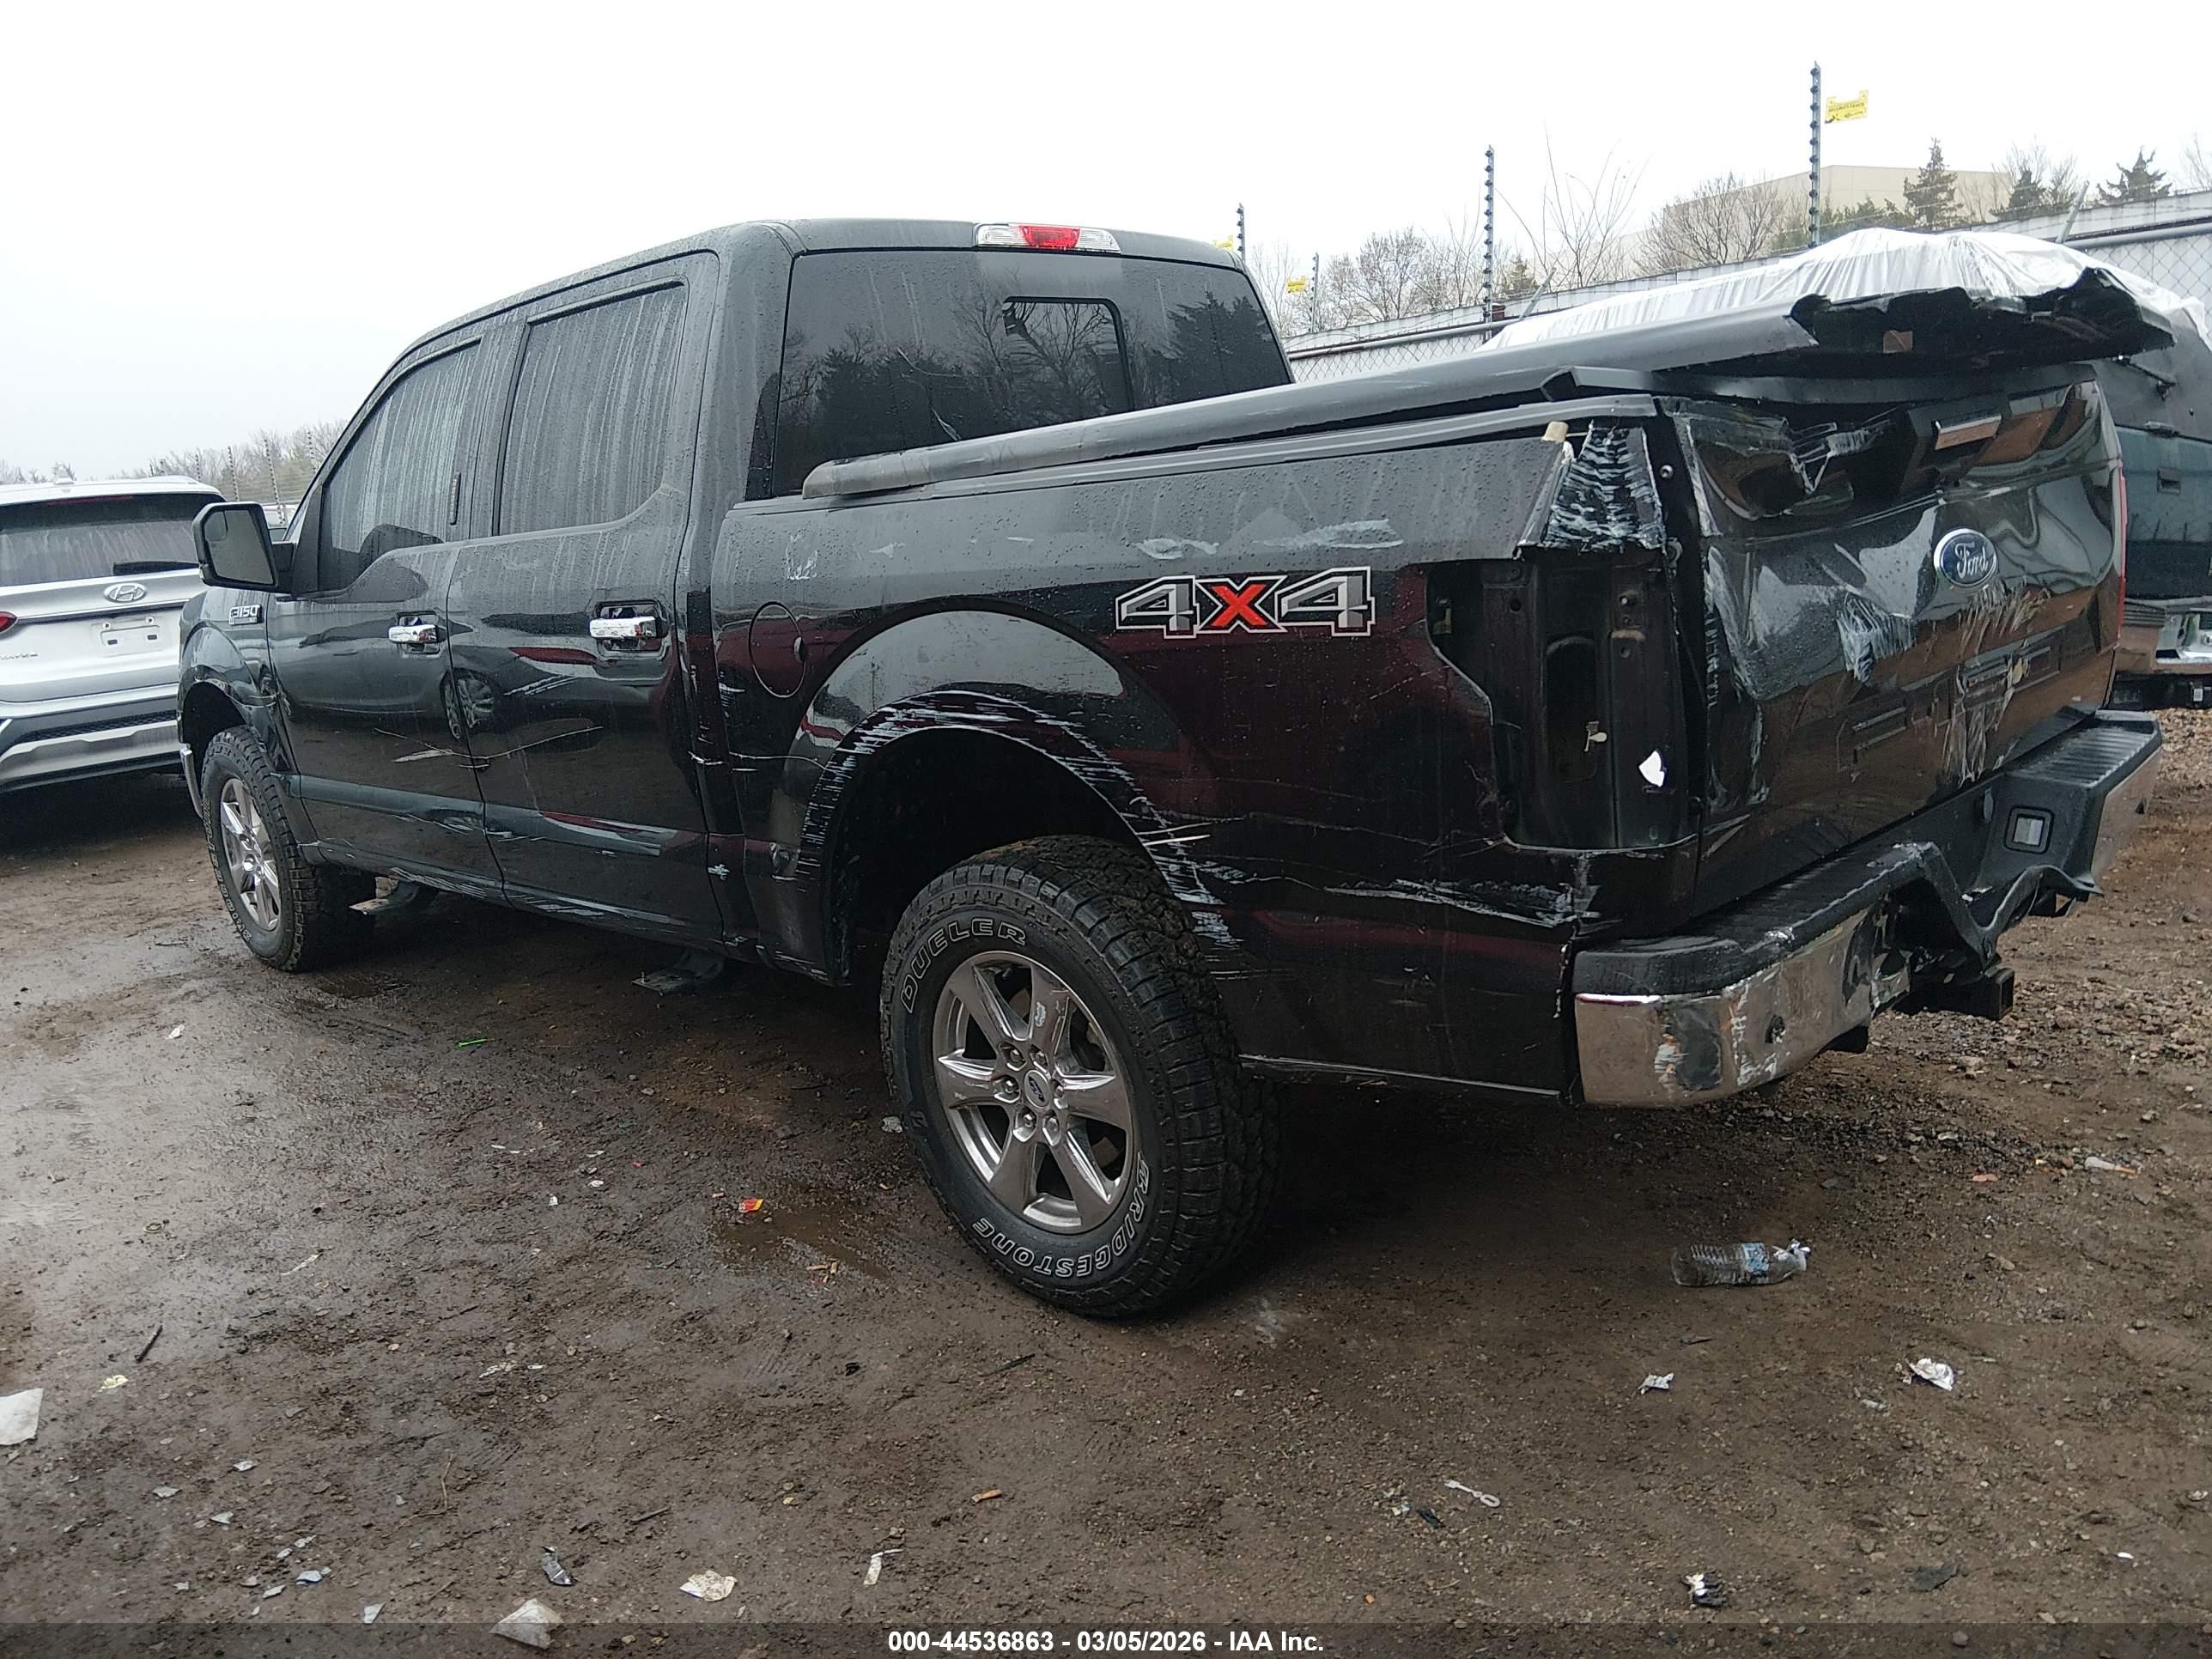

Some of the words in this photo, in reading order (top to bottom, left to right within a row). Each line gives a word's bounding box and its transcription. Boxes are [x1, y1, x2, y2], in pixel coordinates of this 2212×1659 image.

[1954, 541, 1989, 579] Ford
[1115, 566, 1376, 639] 4X4
[901, 918, 1026, 1013] DUELER
[972, 1152, 1150, 1278] BRIDGESTONE
